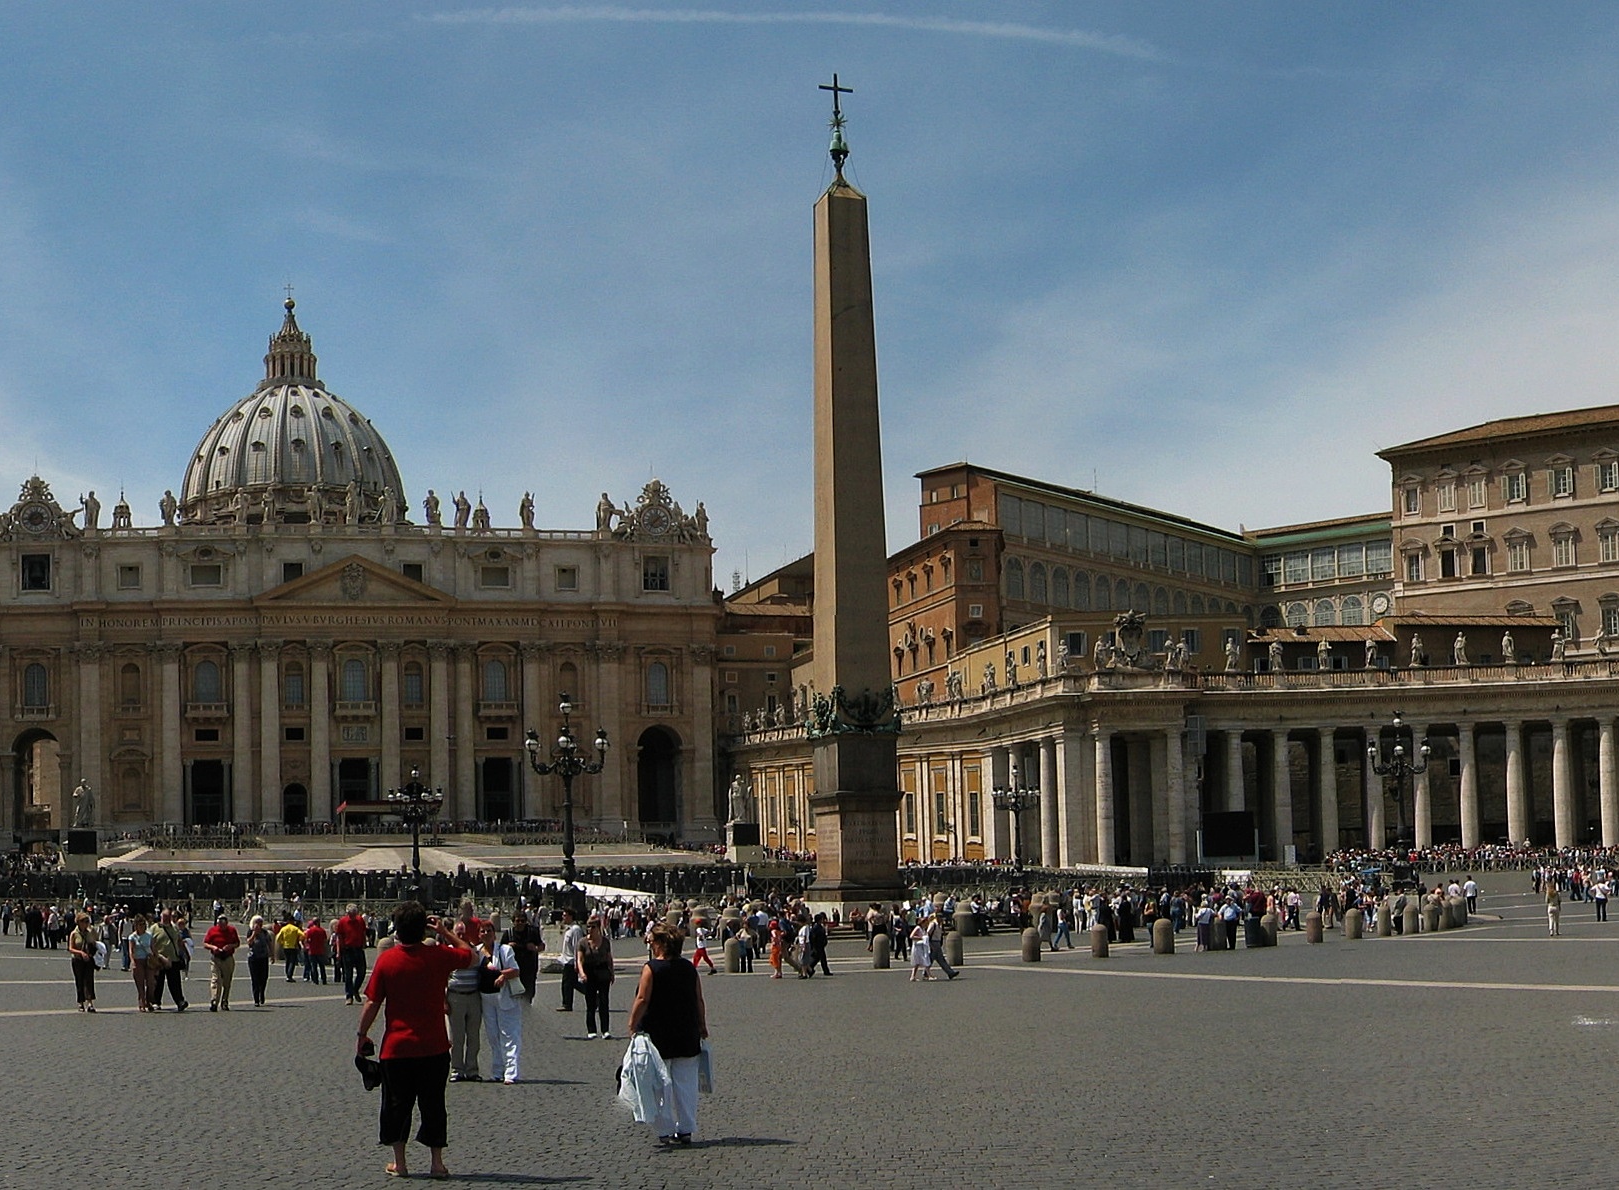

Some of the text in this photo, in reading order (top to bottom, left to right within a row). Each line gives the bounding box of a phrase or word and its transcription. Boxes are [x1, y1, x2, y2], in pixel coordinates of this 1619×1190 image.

[81, 617, 94, 627] IN
[99, 618, 159, 628] HONOREM
[162, 616, 222, 627] PRINCIPIS
[224, 615, 259, 626] APOST
[262, 615, 301, 625] PAVLVS
[313, 615, 384, 625] BVRGHESIVS
[388, 615, 447, 626] ROMANVS
[448, 617, 477, 627] PONT
[477, 617, 502, 627] MAX
[566, 618, 596, 629] PONT
[599, 617, 618, 627] VII
